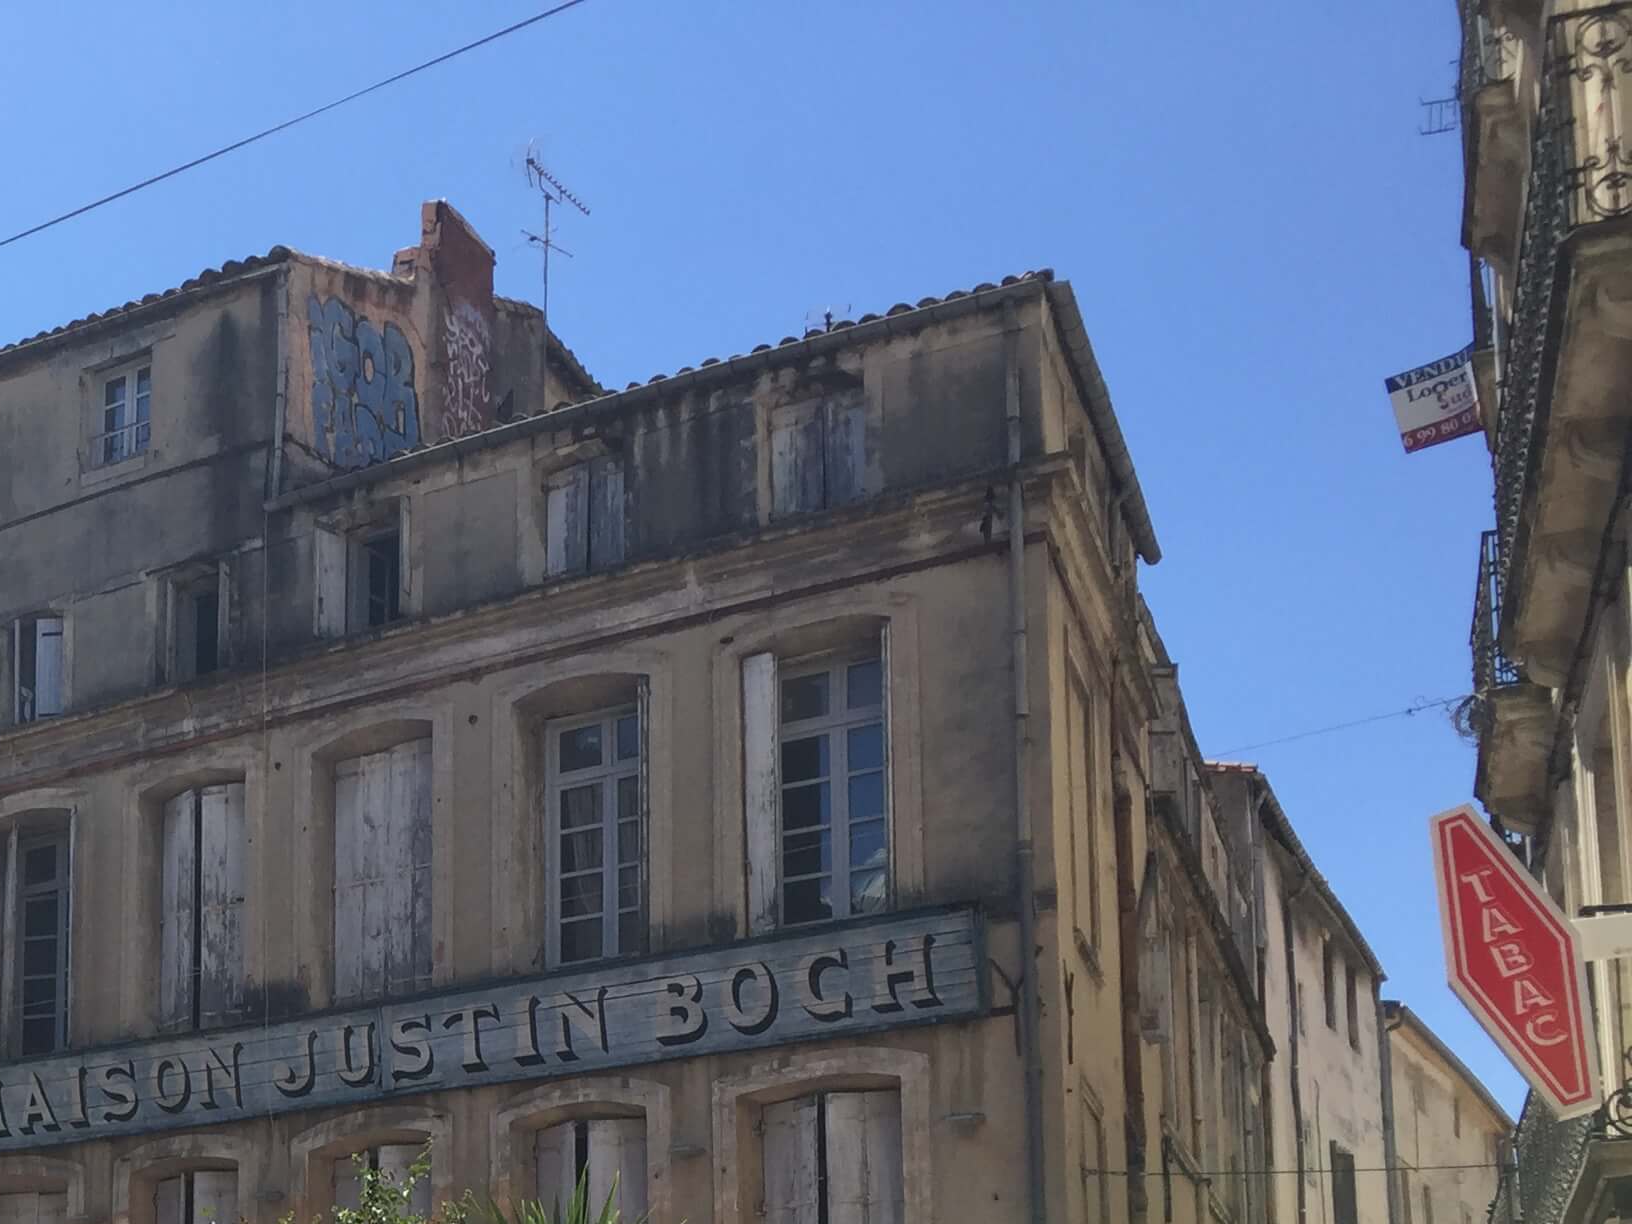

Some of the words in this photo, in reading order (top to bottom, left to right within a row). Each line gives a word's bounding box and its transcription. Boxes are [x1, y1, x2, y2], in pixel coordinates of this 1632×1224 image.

[1394, 351, 1469, 388] VENDU
[1407, 371, 1468, 403] Loger
[1460, 865, 1569, 1046] TABAC
[273, 985, 609, 1098] JUSTIN
[655, 933, 945, 1047] BOCH
